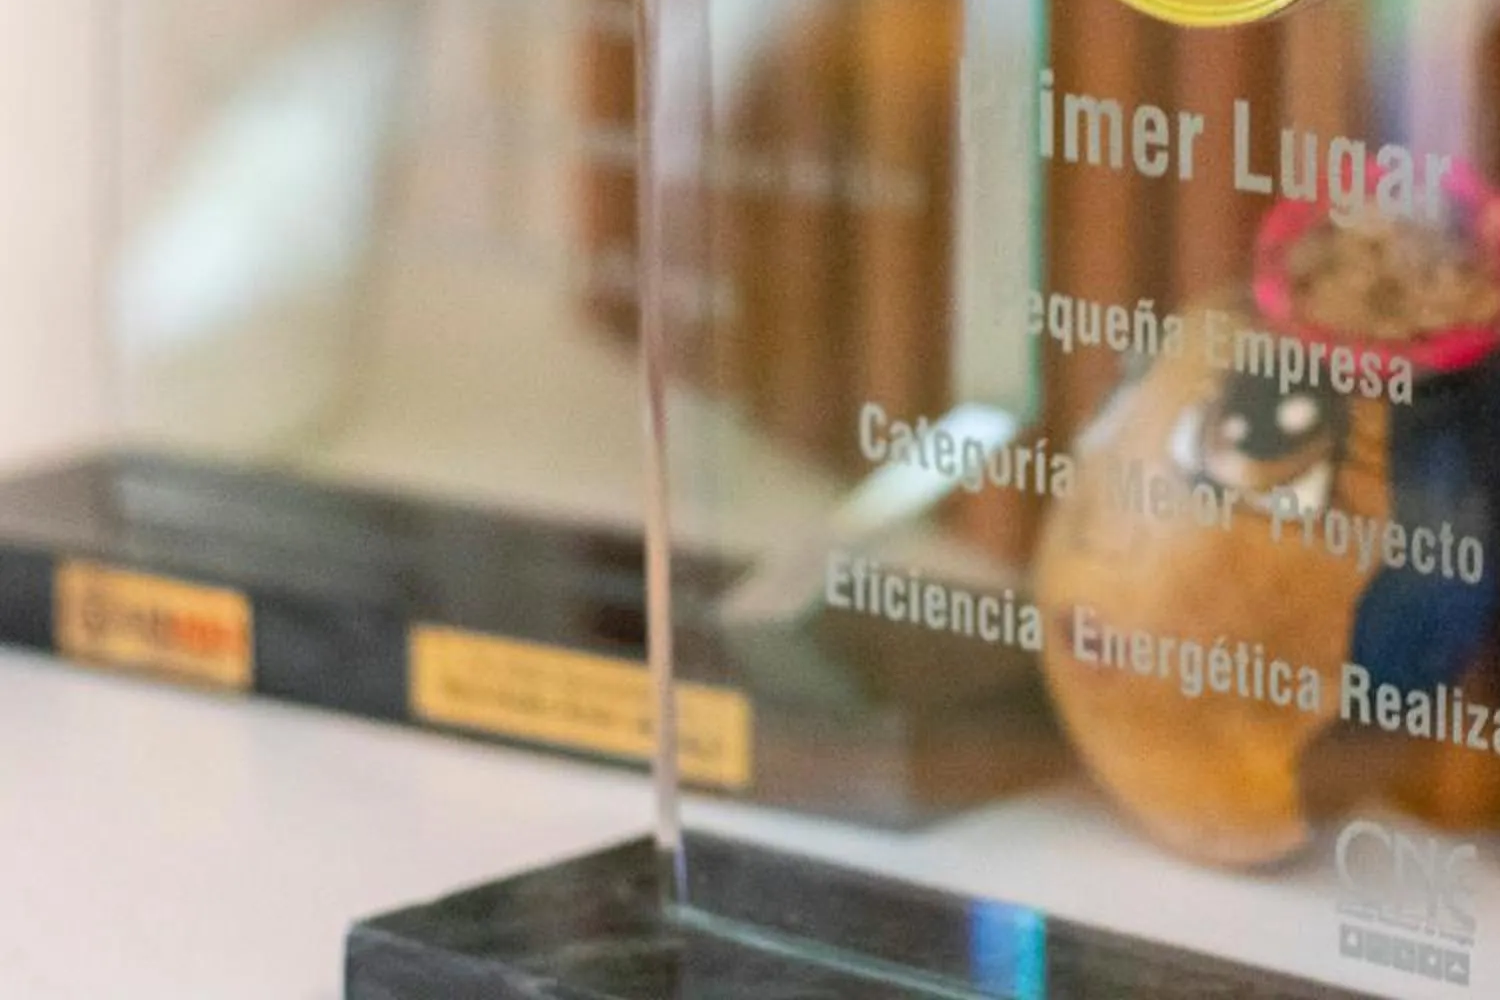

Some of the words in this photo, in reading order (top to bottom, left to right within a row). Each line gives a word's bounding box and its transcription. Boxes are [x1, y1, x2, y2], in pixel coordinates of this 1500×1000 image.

[1233, 98, 1452, 227] Lugar
[1026, 289, 1184, 359] equeña
[1203, 308, 1414, 404] Empresa
[858, 401, 1076, 500] Categoría
[1269, 486, 1485, 586] Proyecto
[825, 551, 1044, 652] Eficiencia
[1073, 605, 1321, 714] Energética
